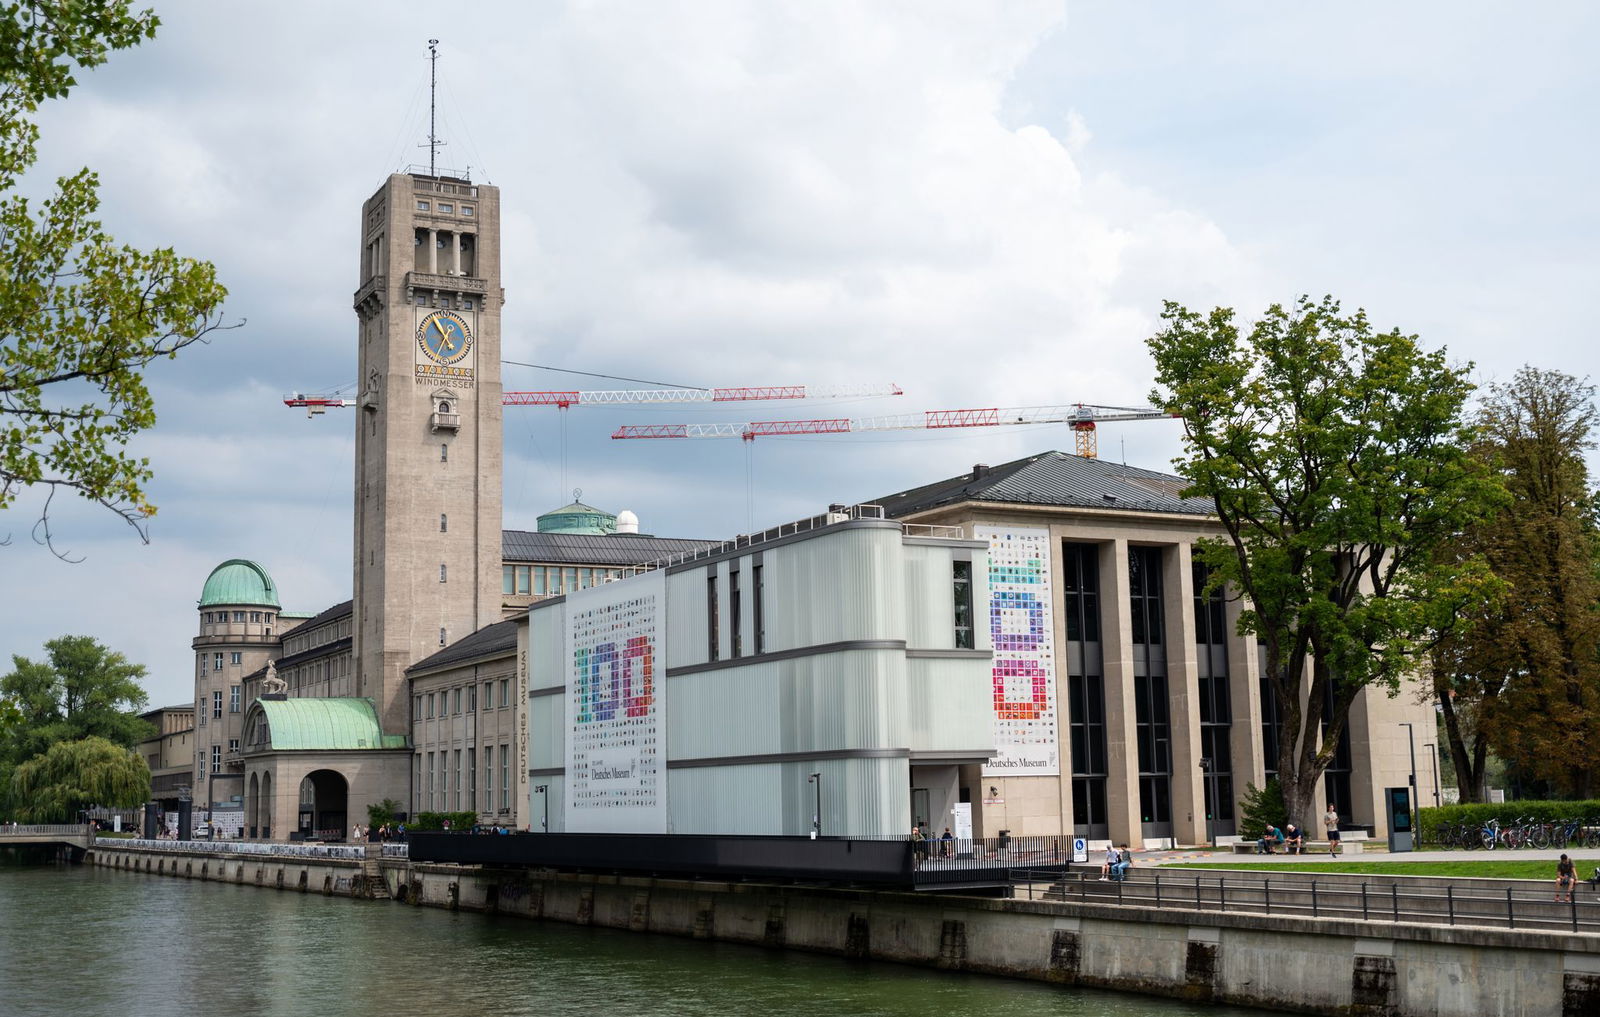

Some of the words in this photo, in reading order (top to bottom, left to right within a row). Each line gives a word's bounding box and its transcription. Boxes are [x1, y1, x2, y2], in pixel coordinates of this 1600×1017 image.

[415, 378, 474, 389] WINDMESSER
[1019, 757, 1047, 768] Museum
[592, 767, 611, 780] Deutsches
[612, 767, 630, 779] Museum
